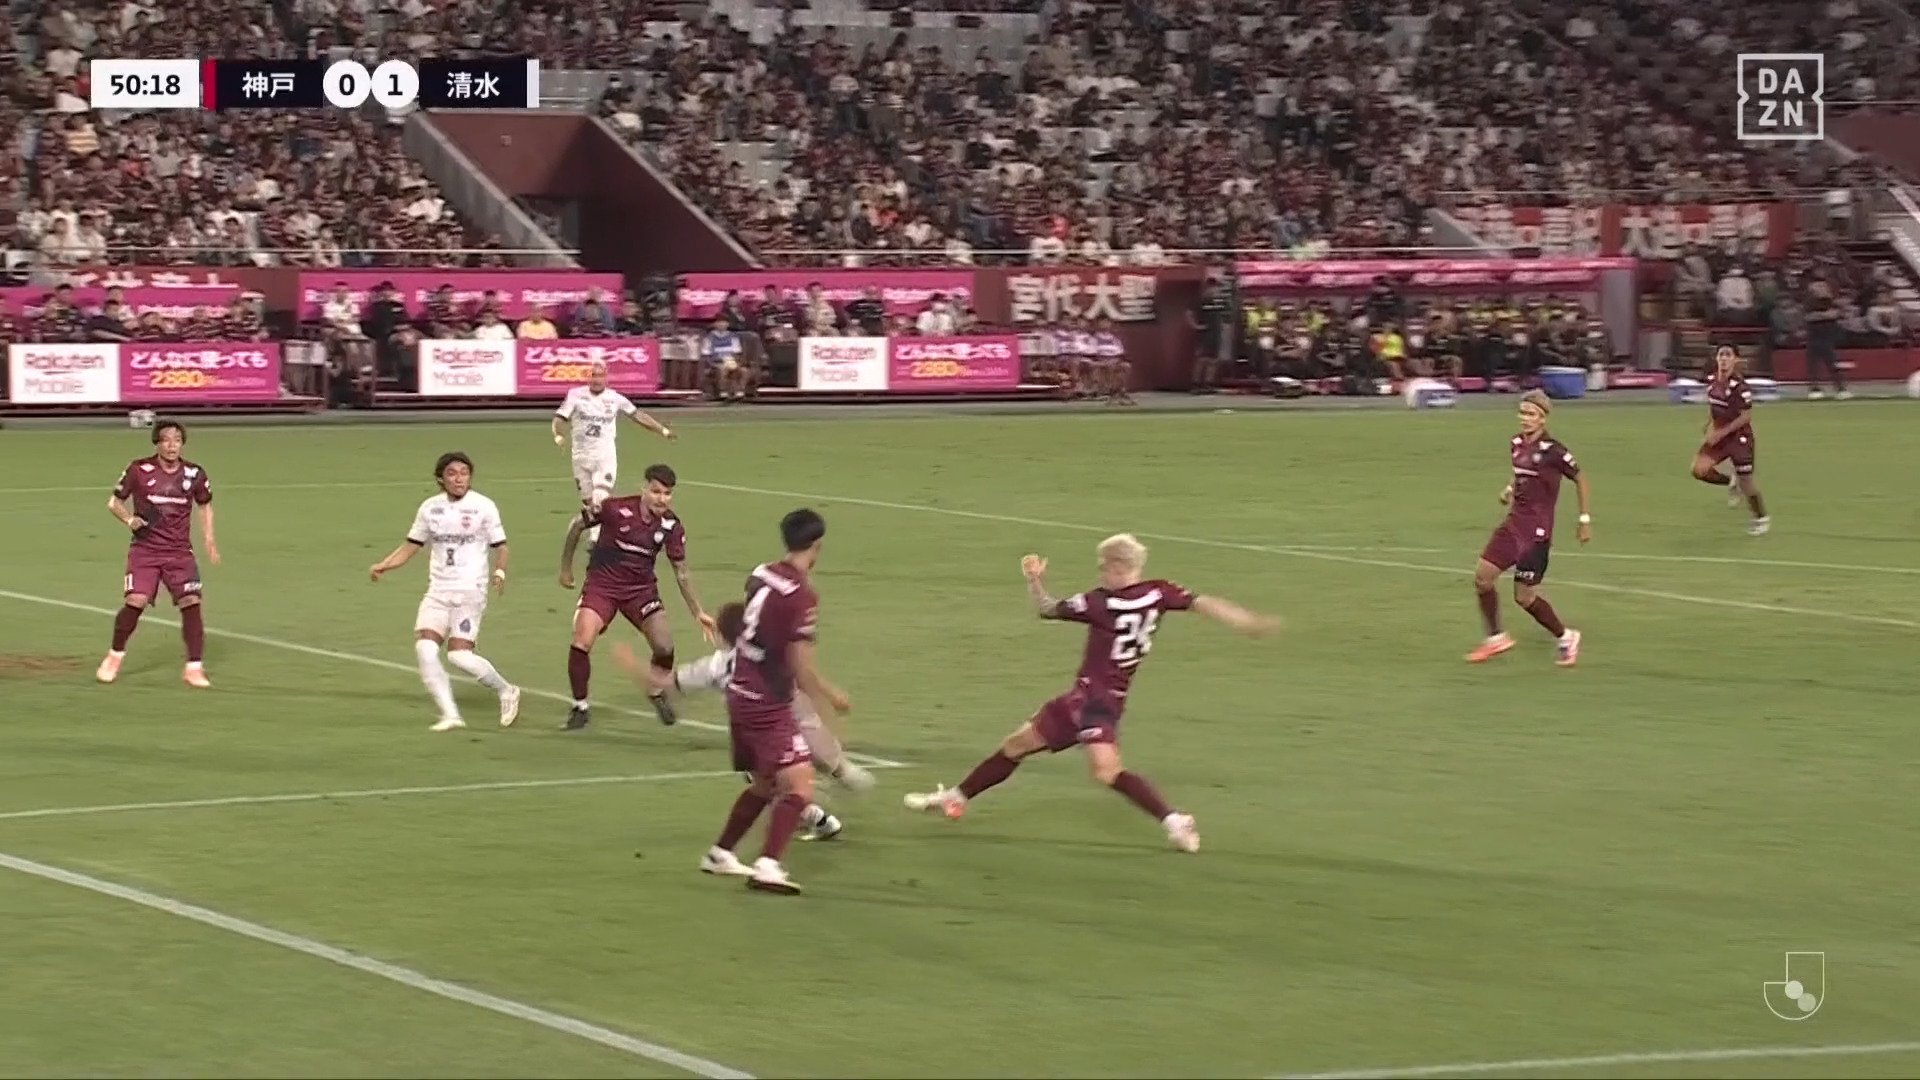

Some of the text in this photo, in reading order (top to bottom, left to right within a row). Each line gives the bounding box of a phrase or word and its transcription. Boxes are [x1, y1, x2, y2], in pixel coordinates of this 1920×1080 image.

[23, 352, 106, 370] Rakuten
[432, 347, 504, 364] Rakuten
[811, 344, 877, 360] Rakuten
[446, 547, 455, 566] 8
[1110, 609, 1160, 661] 24
